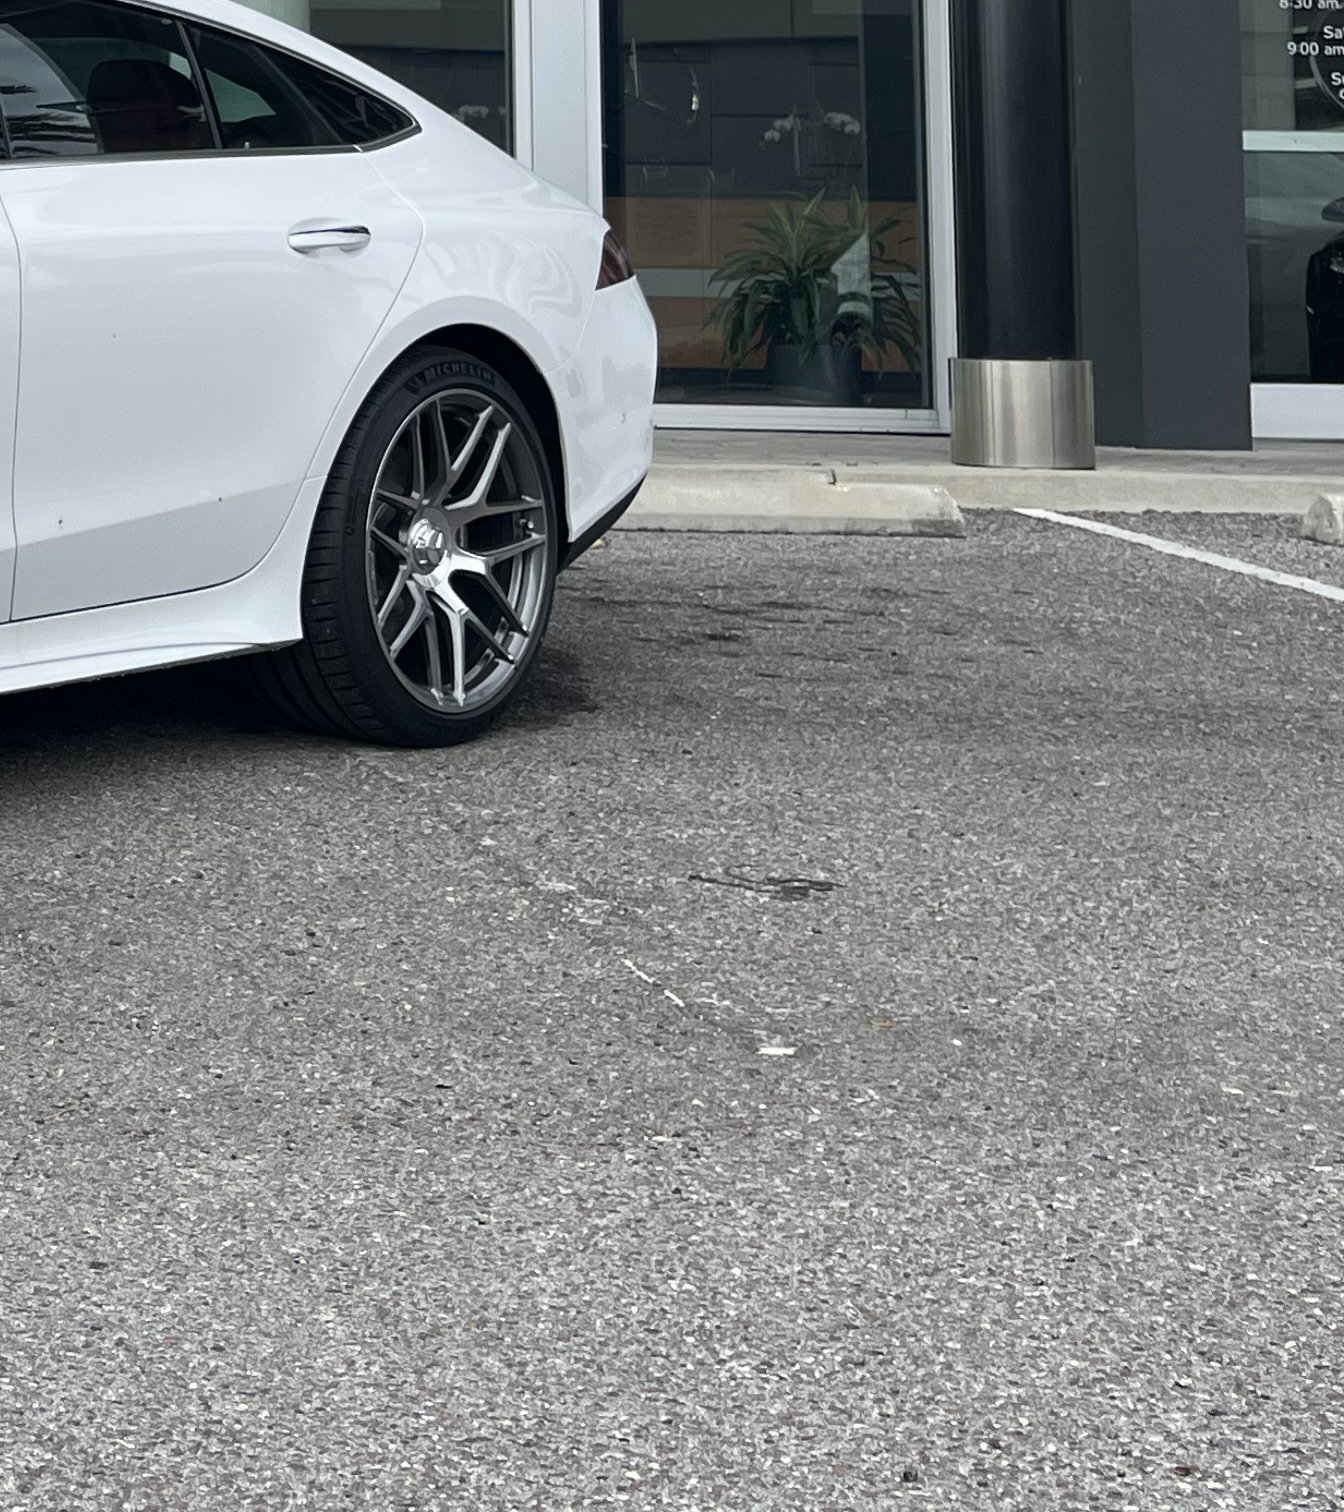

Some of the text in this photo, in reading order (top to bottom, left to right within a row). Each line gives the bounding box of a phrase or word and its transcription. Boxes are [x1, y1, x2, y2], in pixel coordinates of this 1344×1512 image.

[1323, 25, 1344, 39] Sa
[1287, 41, 1319, 55] 9:00
[423, 362, 492, 381] MICHELIN
